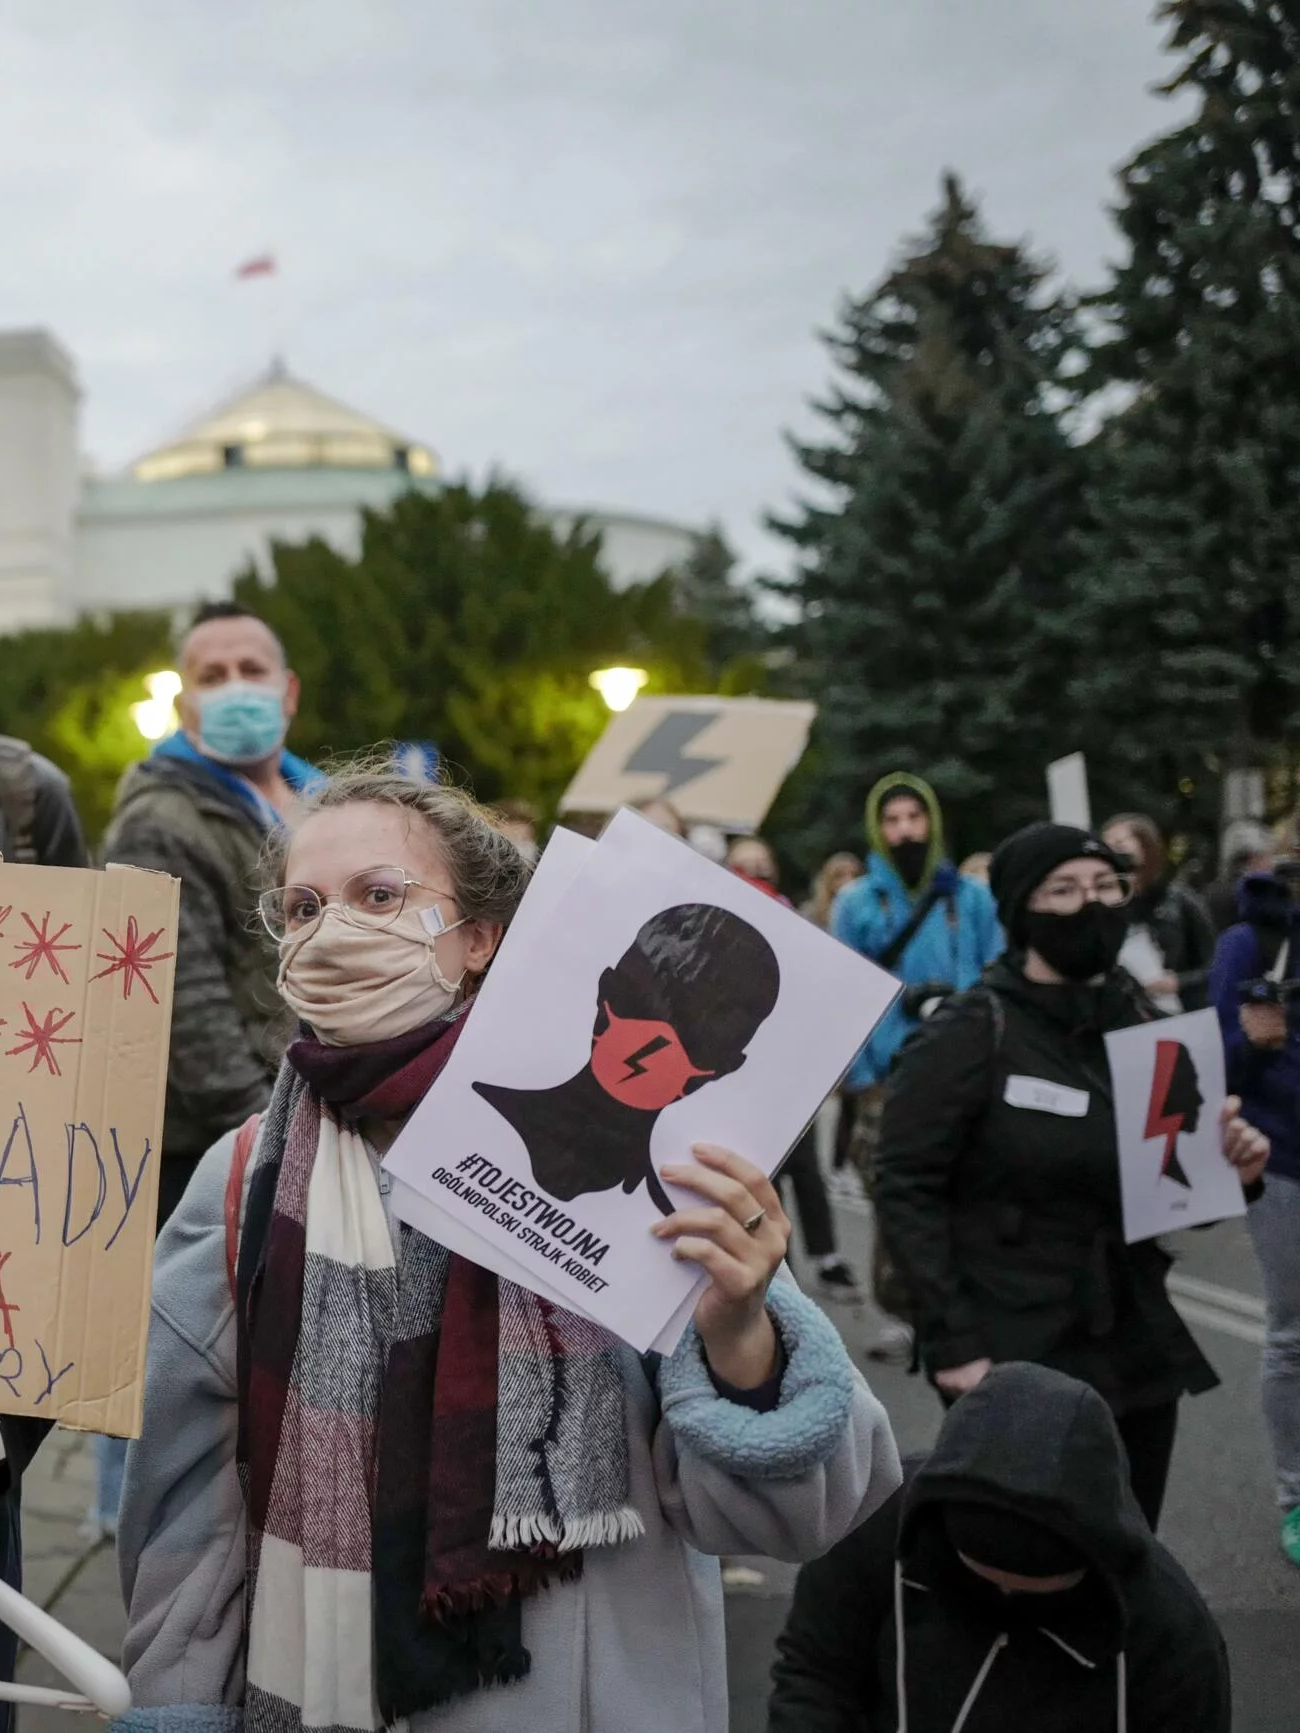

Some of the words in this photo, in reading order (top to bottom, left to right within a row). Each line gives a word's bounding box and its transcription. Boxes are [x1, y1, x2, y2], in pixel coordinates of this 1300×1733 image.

[432, 1167, 522, 1233] OGÓLNOPOLSKI
[517, 1227, 566, 1265] STRAJK
[560, 1257, 610, 1294] KOBIET
[456, 1153, 610, 1266] #TOJESTWOJNA
